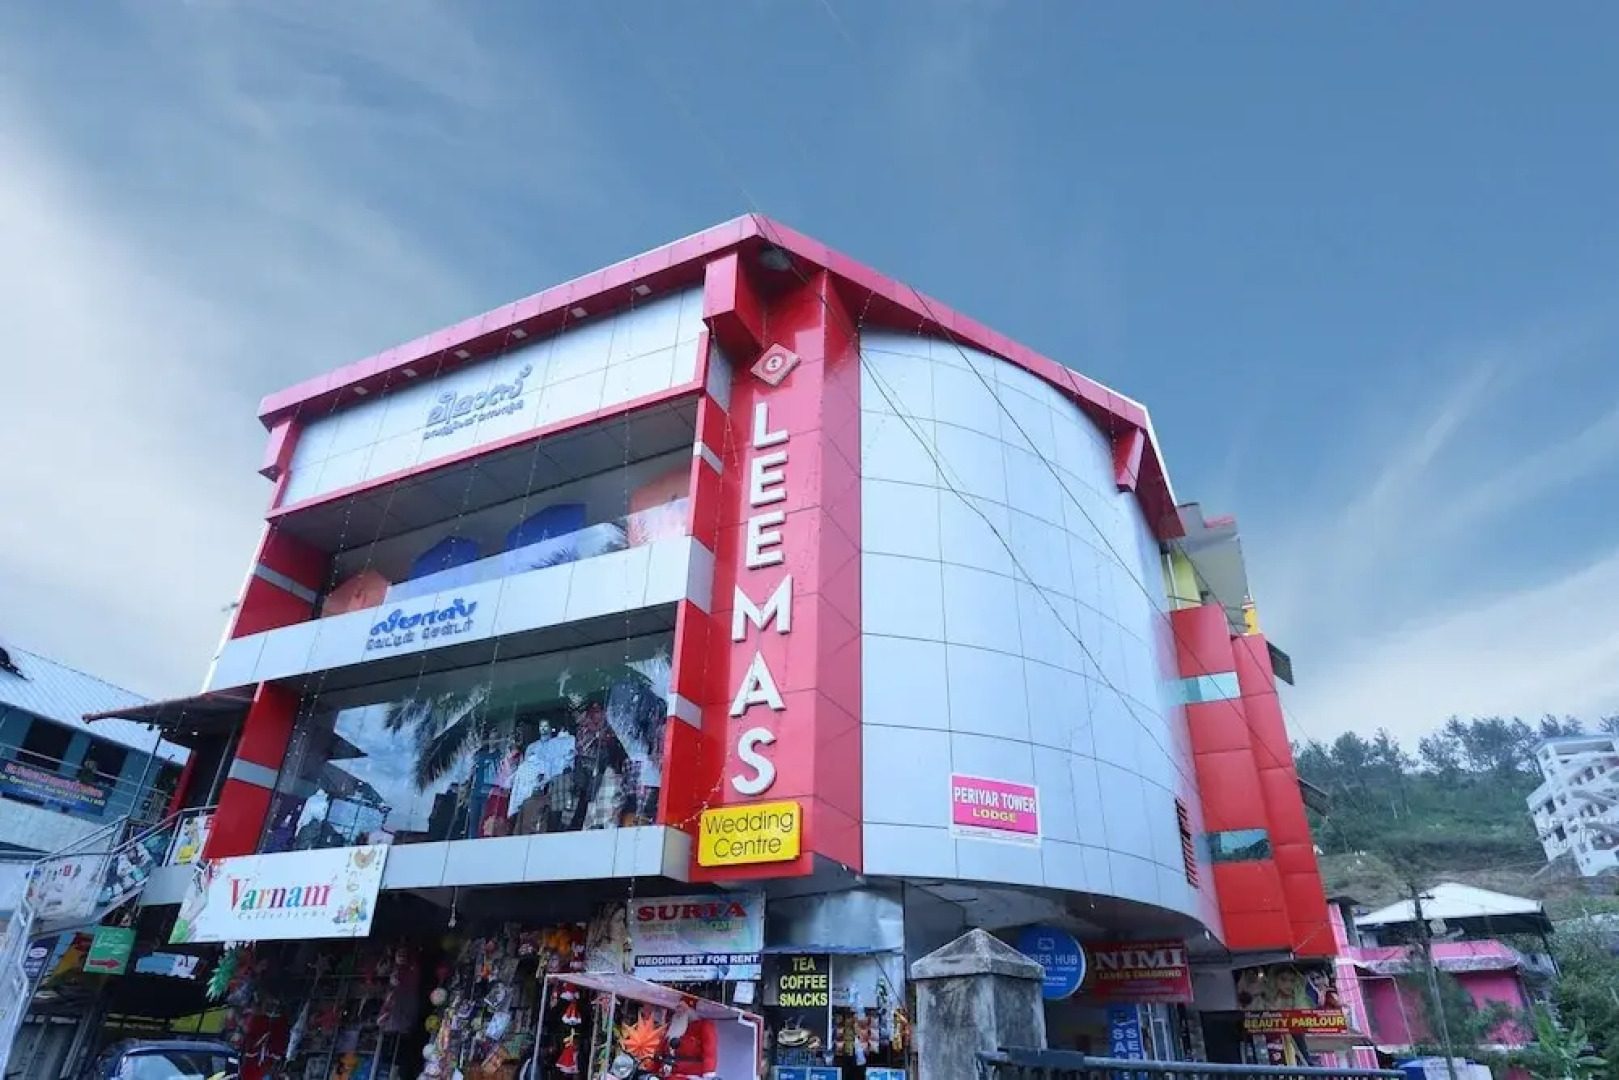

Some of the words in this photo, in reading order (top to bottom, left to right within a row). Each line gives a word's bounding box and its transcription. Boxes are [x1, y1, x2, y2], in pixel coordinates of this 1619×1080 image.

[730, 401, 795, 797] LEEMAS
[953, 786, 999, 808] PERIYAR
[1000, 793, 1037, 814] TOWER
[704, 808, 796, 834] Wedding
[972, 807, 1017, 823] LODGE
[713, 833, 781, 859] Centre
[229, 875, 332, 911] Varnam
[637, 955, 682, 966] WEDDING
[685, 955, 704, 965] SET
[706, 954, 728, 965] FOR
[729, 953, 759, 964] RENT
[792, 957, 816, 971] TEA
[1055, 953, 1078, 965] HUB
[1095, 949, 1187, 971] NIMI
[779, 974, 828, 989] COFFEE
[779, 991, 828, 1007] SNACKS
[1244, 1017, 1288, 1028] BEAUTY
[1291, 1016, 1344, 1027] PARLOUR
